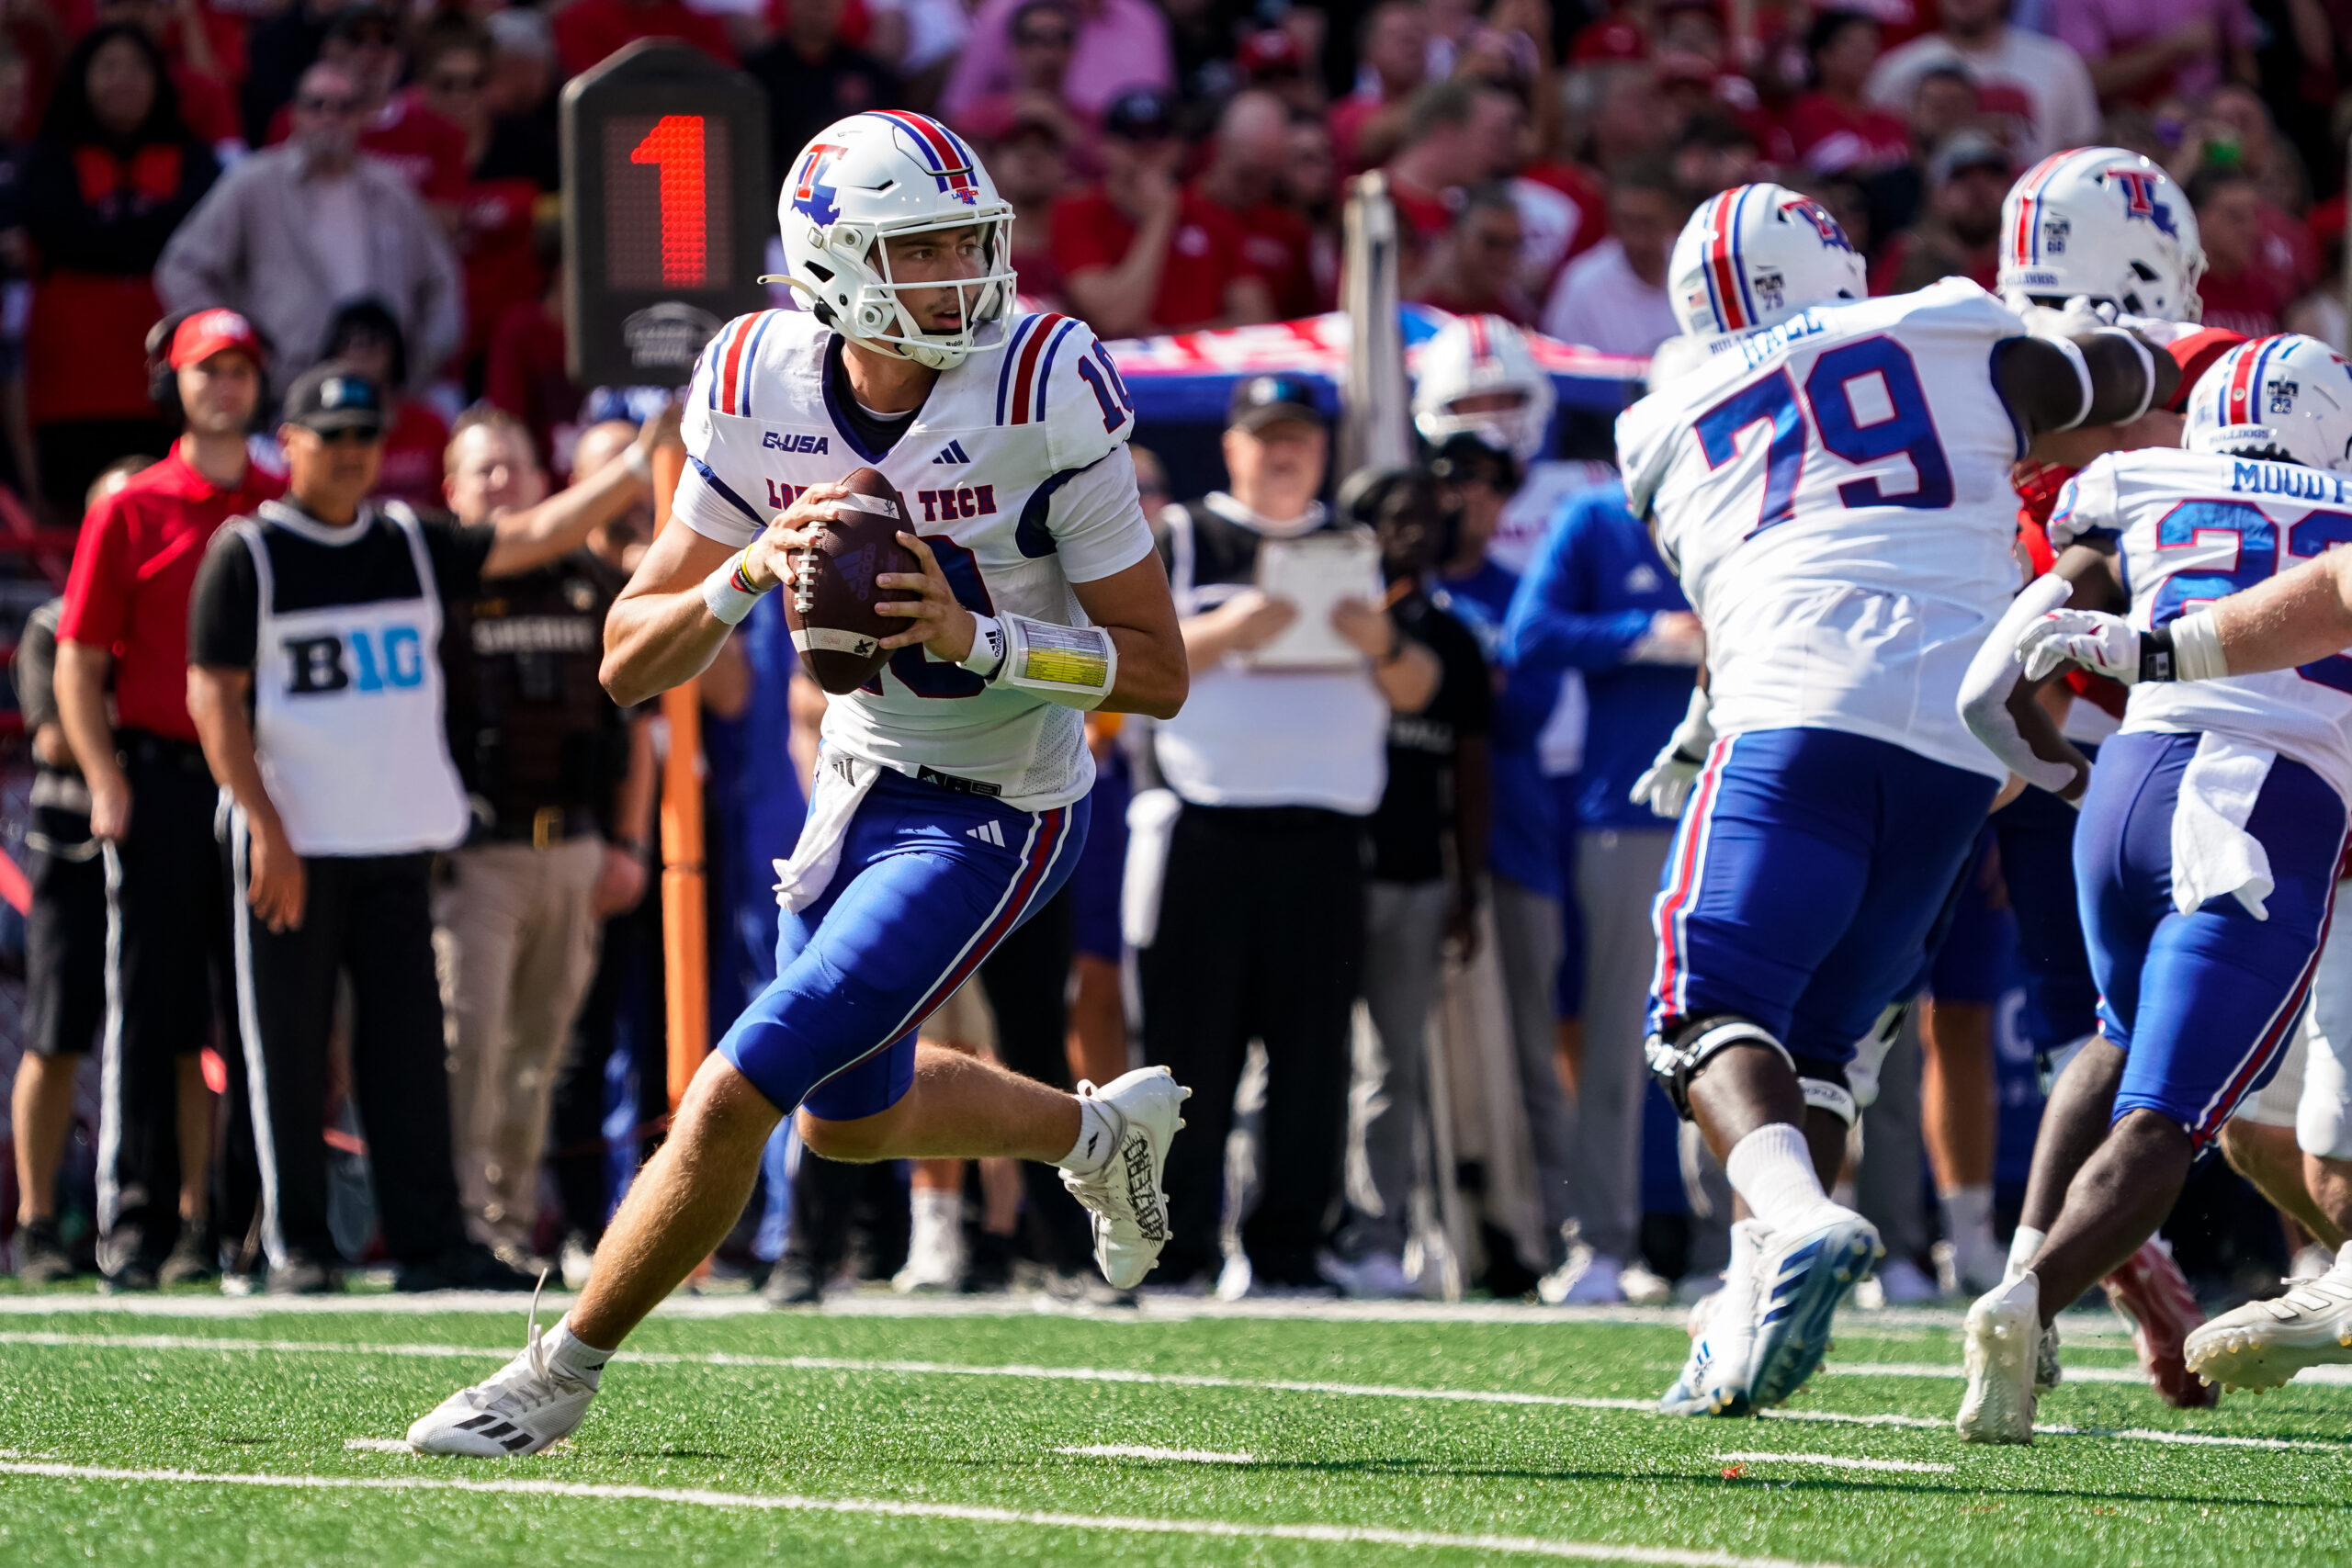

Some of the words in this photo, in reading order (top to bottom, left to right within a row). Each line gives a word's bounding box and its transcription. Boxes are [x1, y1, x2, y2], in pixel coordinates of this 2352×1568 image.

[630, 115, 707, 289] 1
[1693, 333, 1956, 542] 79
[918, 484, 996, 521] TECH
[994, 628, 1002, 658] adidas
